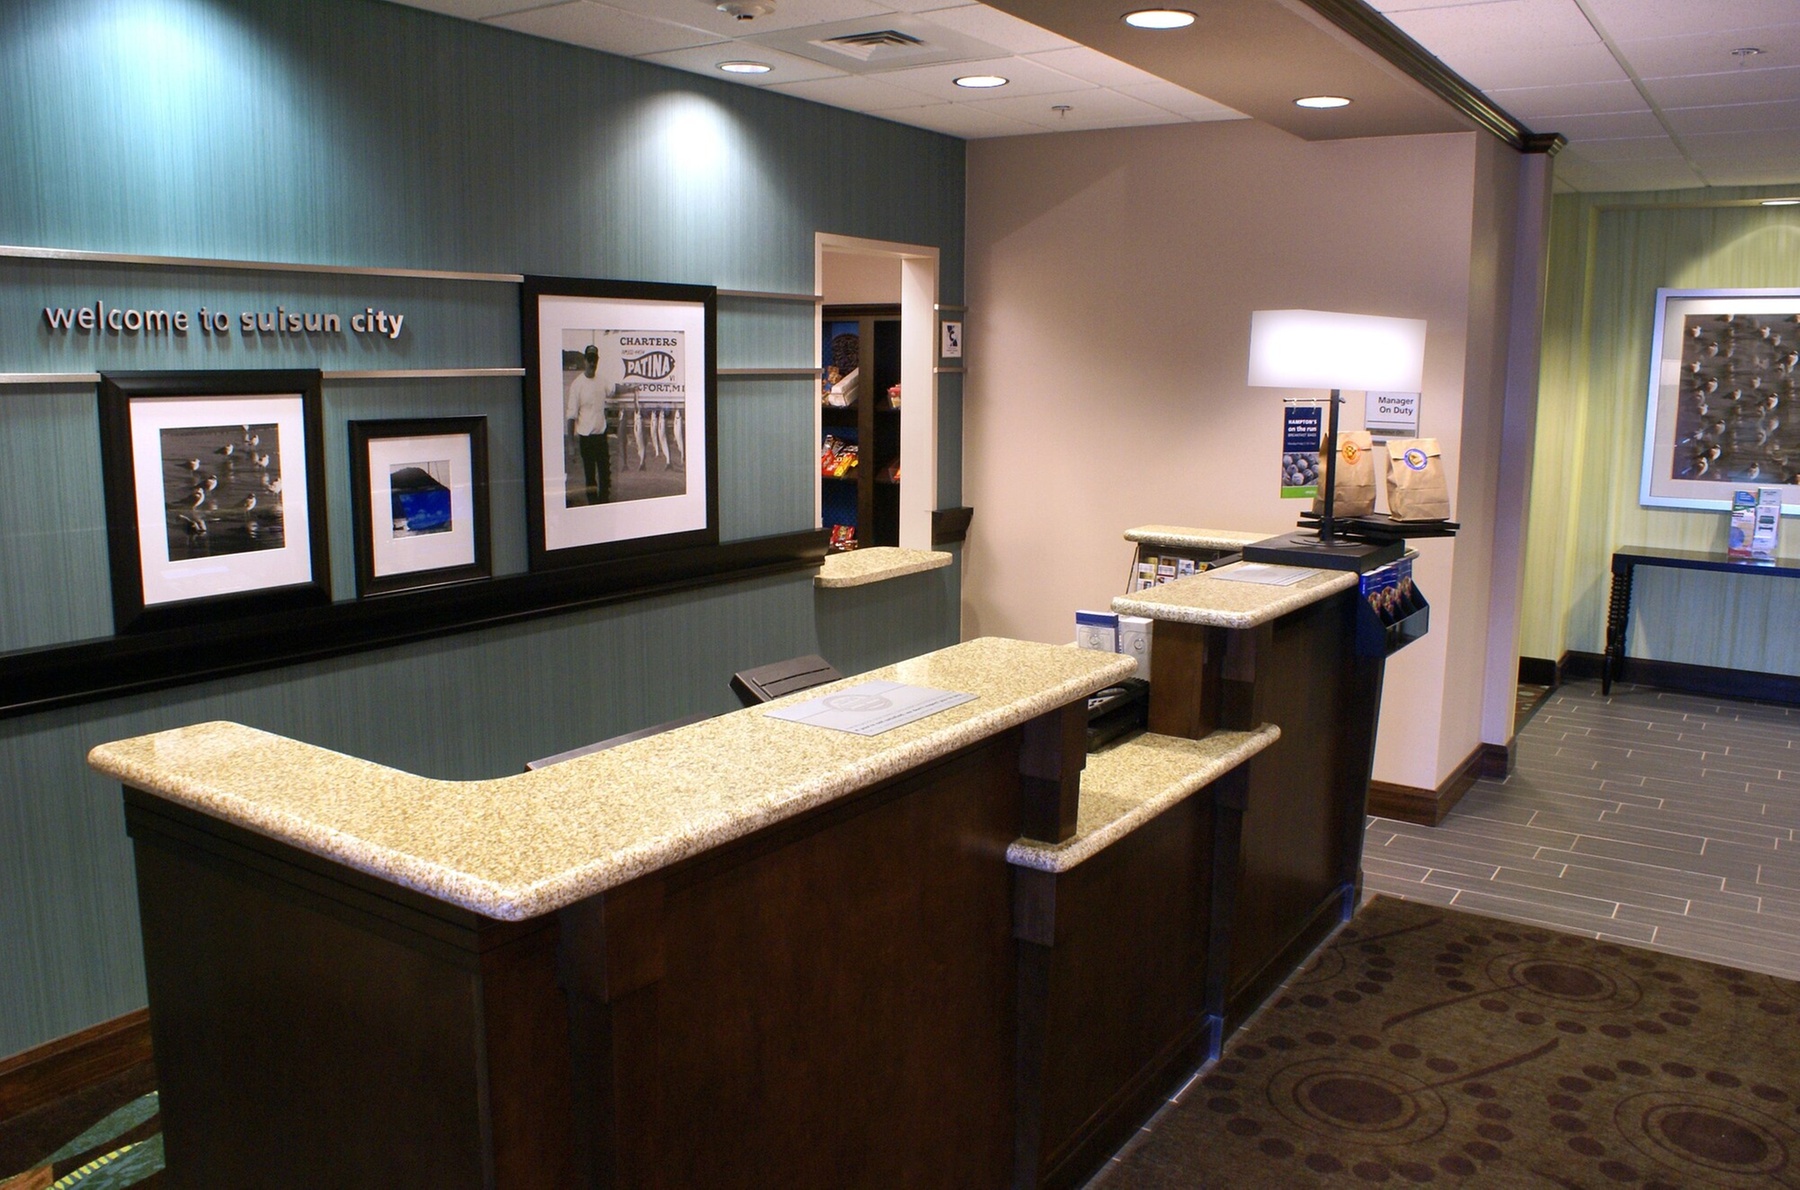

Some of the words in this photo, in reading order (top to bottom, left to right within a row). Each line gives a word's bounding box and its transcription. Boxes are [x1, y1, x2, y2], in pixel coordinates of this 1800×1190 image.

[45, 300, 188, 331] welcome
[200, 306, 229, 331] to
[240, 306, 341, 332] suisun
[352, 307, 404, 339] city
[620, 337, 678, 346] CHARTERS
[627, 353, 671, 378] PATINA
[1378, 397, 1414, 406] Manager
[1393, 406, 1414, 416] Duty
